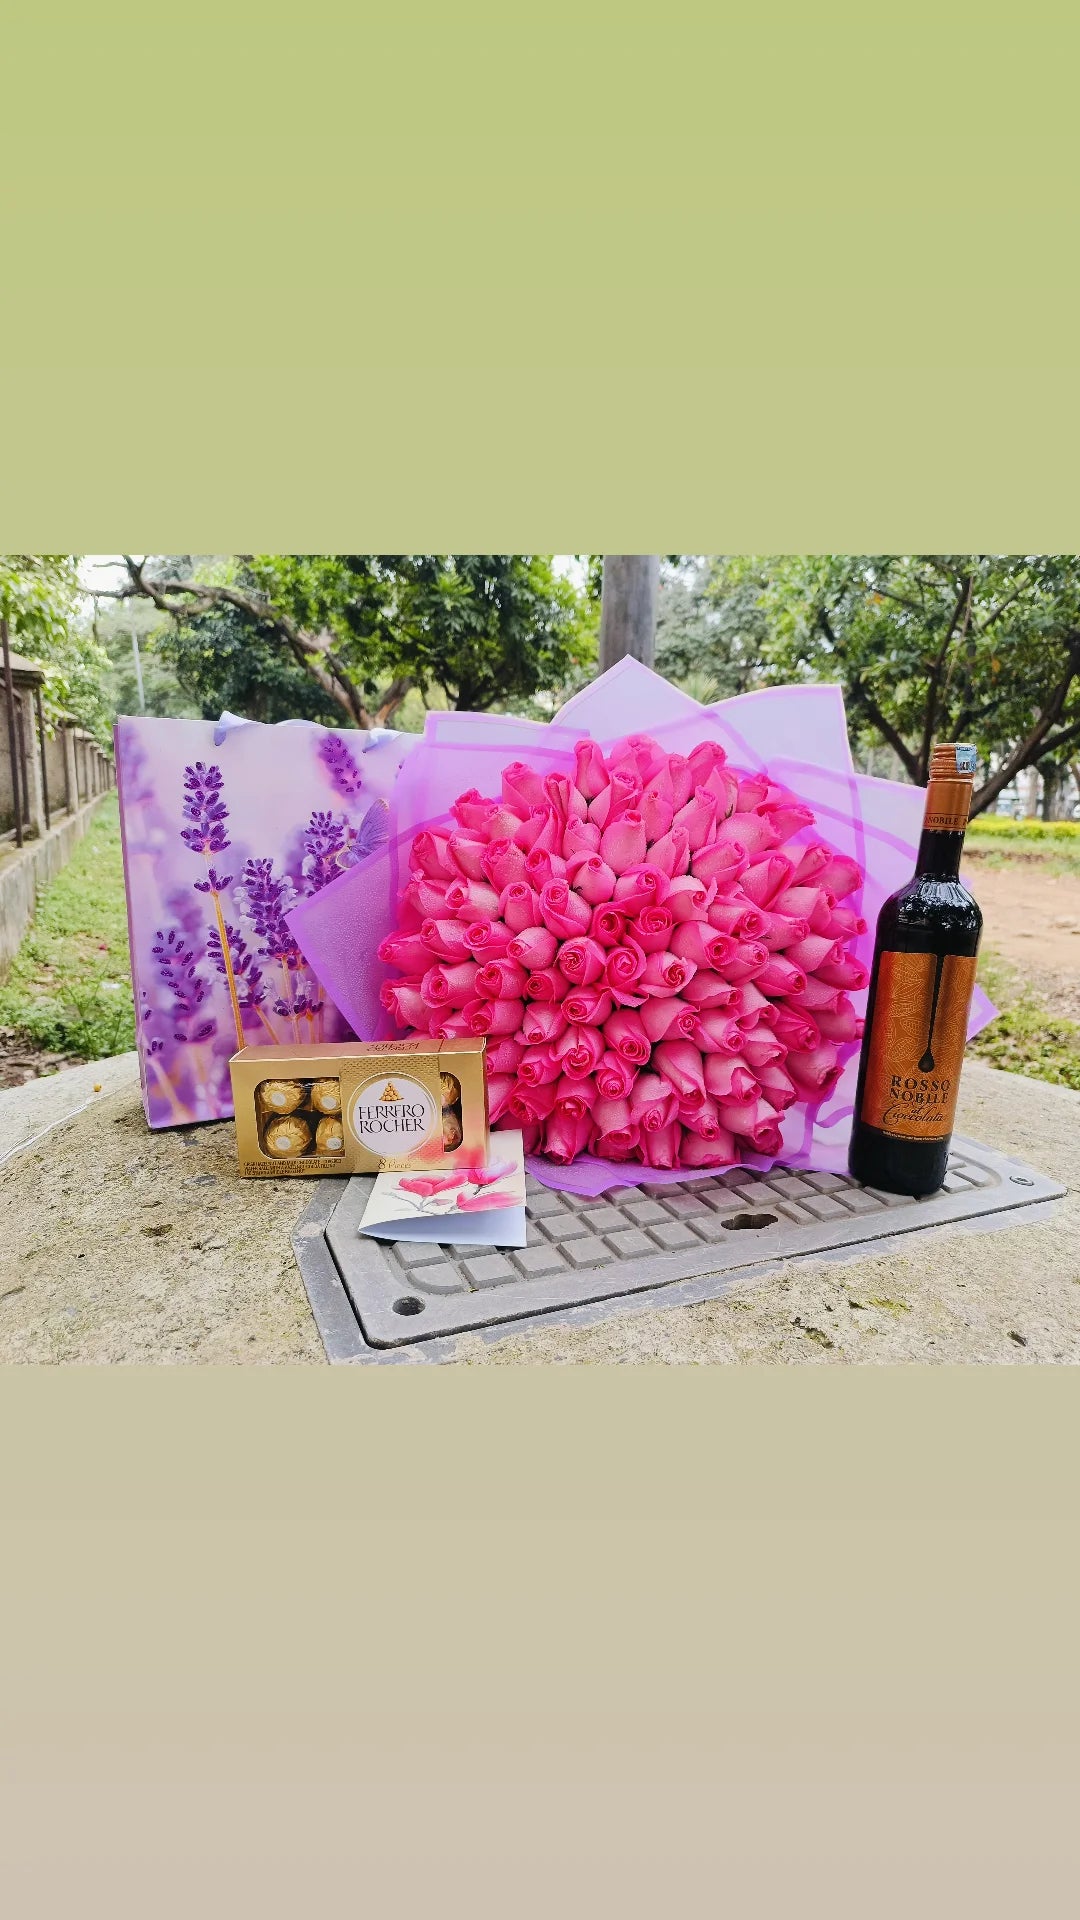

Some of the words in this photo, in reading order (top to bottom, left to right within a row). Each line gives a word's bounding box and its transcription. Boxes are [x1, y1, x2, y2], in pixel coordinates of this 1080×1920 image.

[927, 816, 959, 826] NOBILE
[891, 1075, 951, 1092] ROSSO
[890, 1087, 949, 1104] NOBILE
[358, 1103, 425, 1120] FERRERO
[359, 1118, 425, 1134] ROCHER
[378, 1156, 387, 1170] 8
